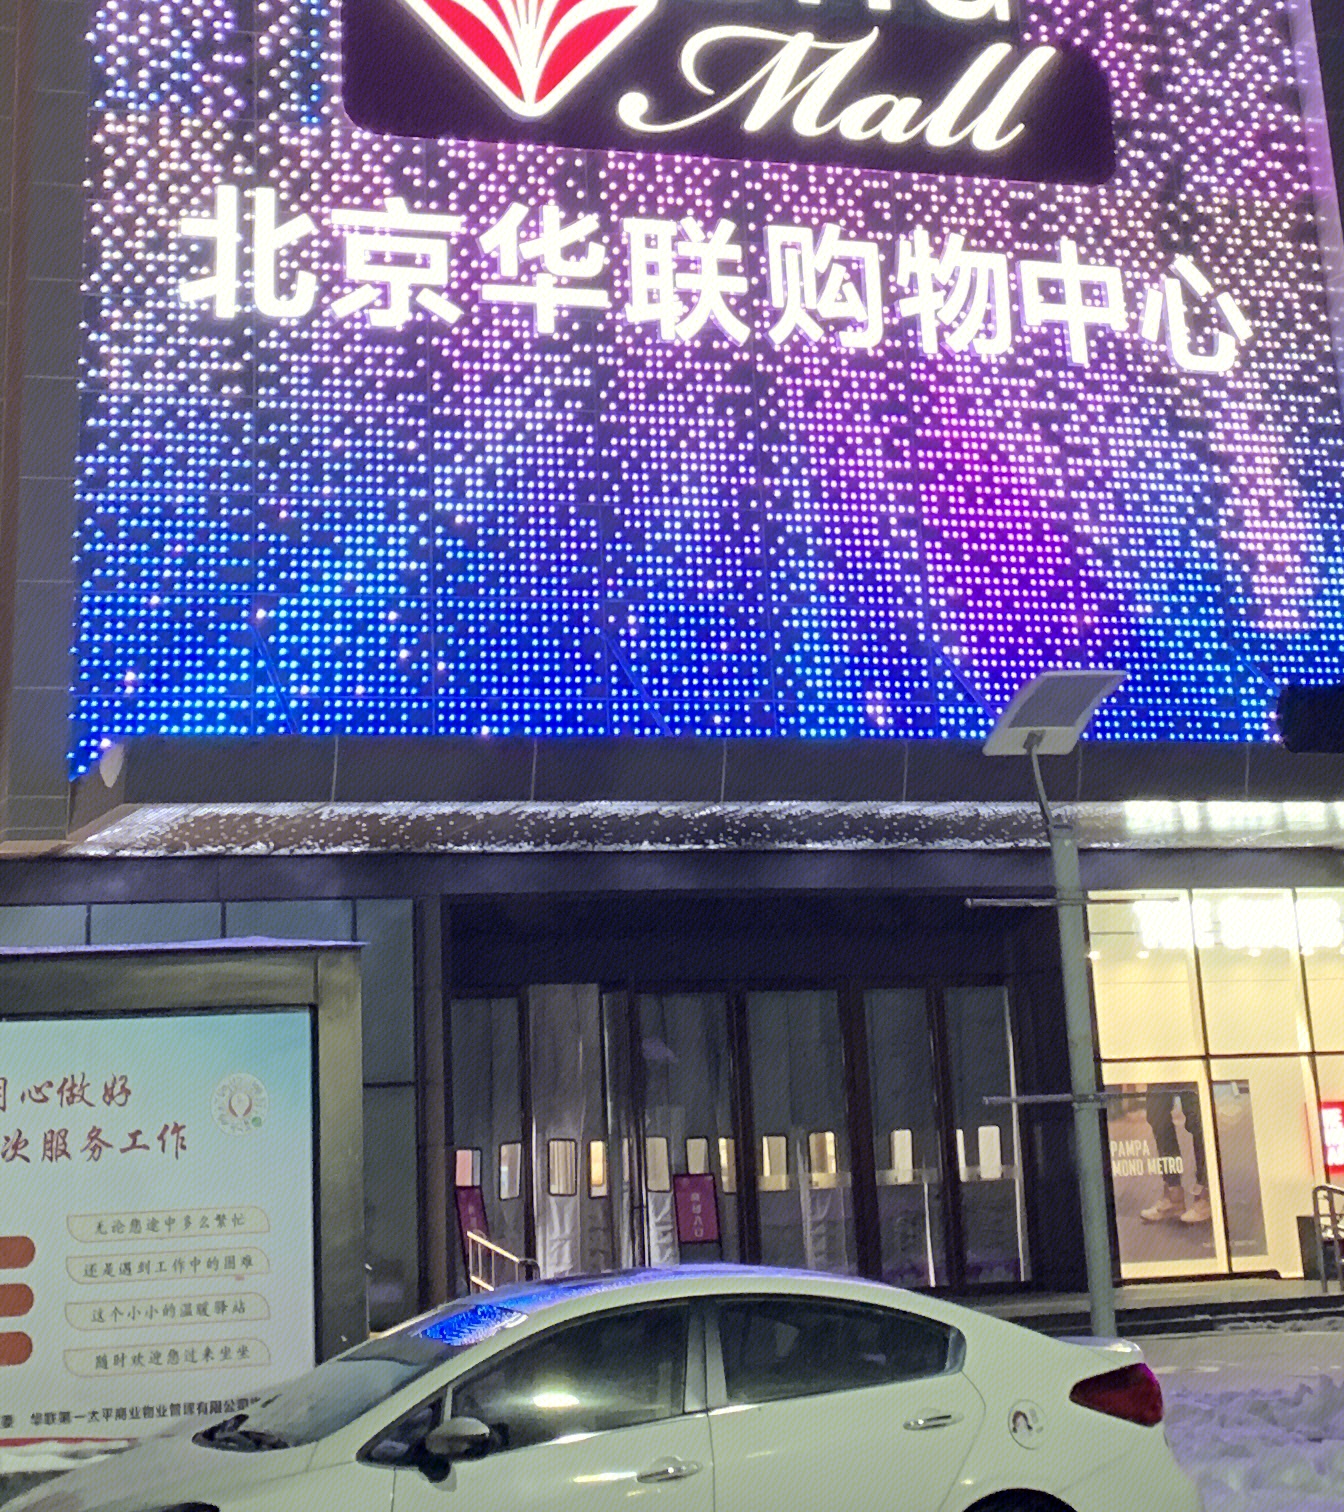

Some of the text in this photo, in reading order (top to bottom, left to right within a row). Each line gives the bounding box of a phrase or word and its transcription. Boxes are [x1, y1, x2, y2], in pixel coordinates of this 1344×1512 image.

[617, 24, 1058, 153] Mall
[178, 186, 1254, 378] 北京华联购物中心
[1109, 1139, 1151, 1158] PAMPA
[1111, 1155, 1184, 1178] MONO METRO
[91, 1298, 247, 1324] 这个小小的温暖驿站
